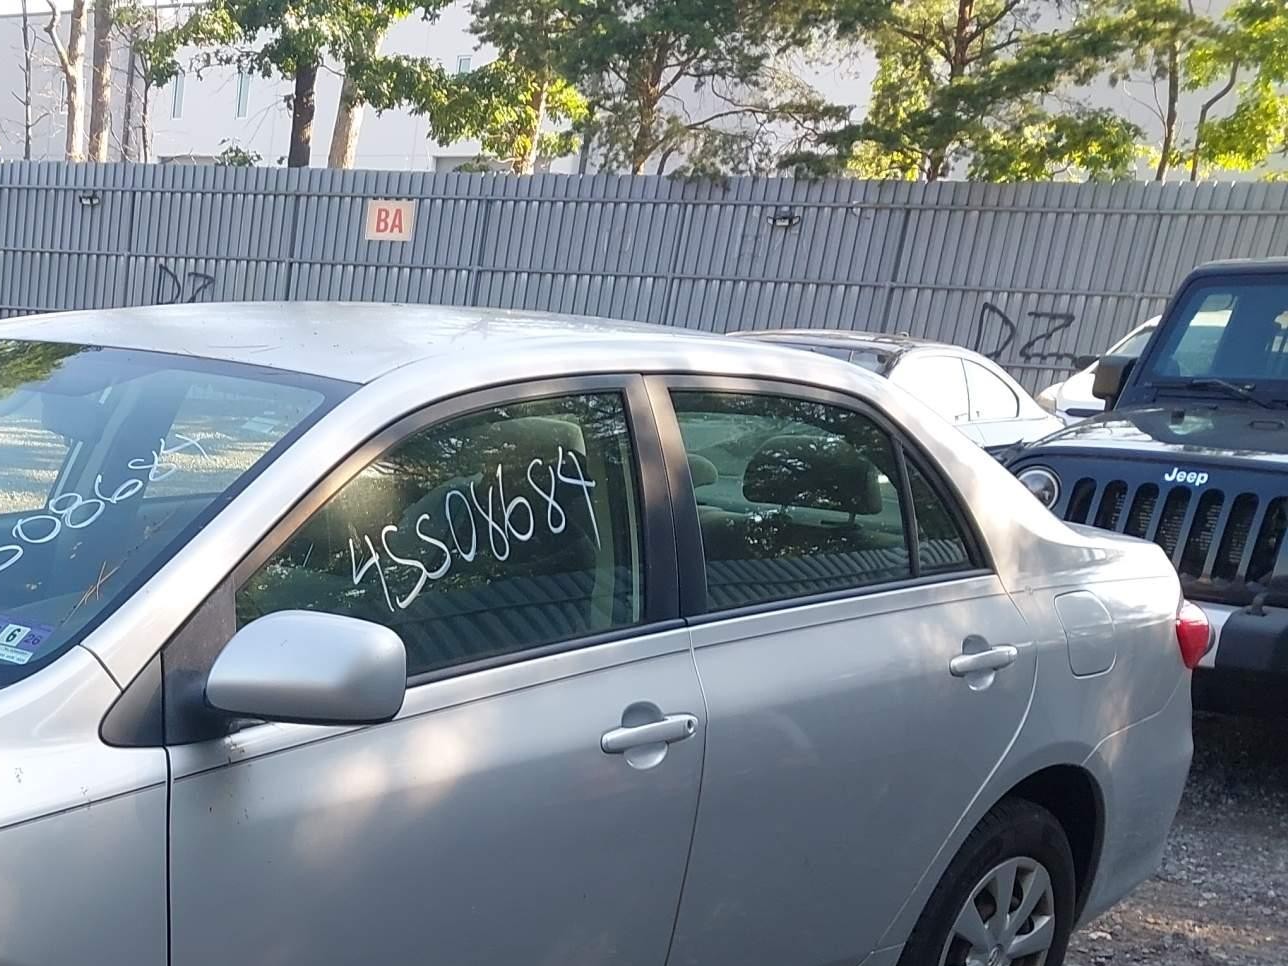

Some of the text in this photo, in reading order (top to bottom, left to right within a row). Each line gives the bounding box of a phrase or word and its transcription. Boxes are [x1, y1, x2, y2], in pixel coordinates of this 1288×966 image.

[375, 207, 403, 234] BA
[974, 301, 1077, 362] DZ
[1164, 467, 1209, 487] Jeep
[348, 445, 602, 614] 45508684
[5, 627, 22, 643] 6
[24, 633, 41, 646] 26
